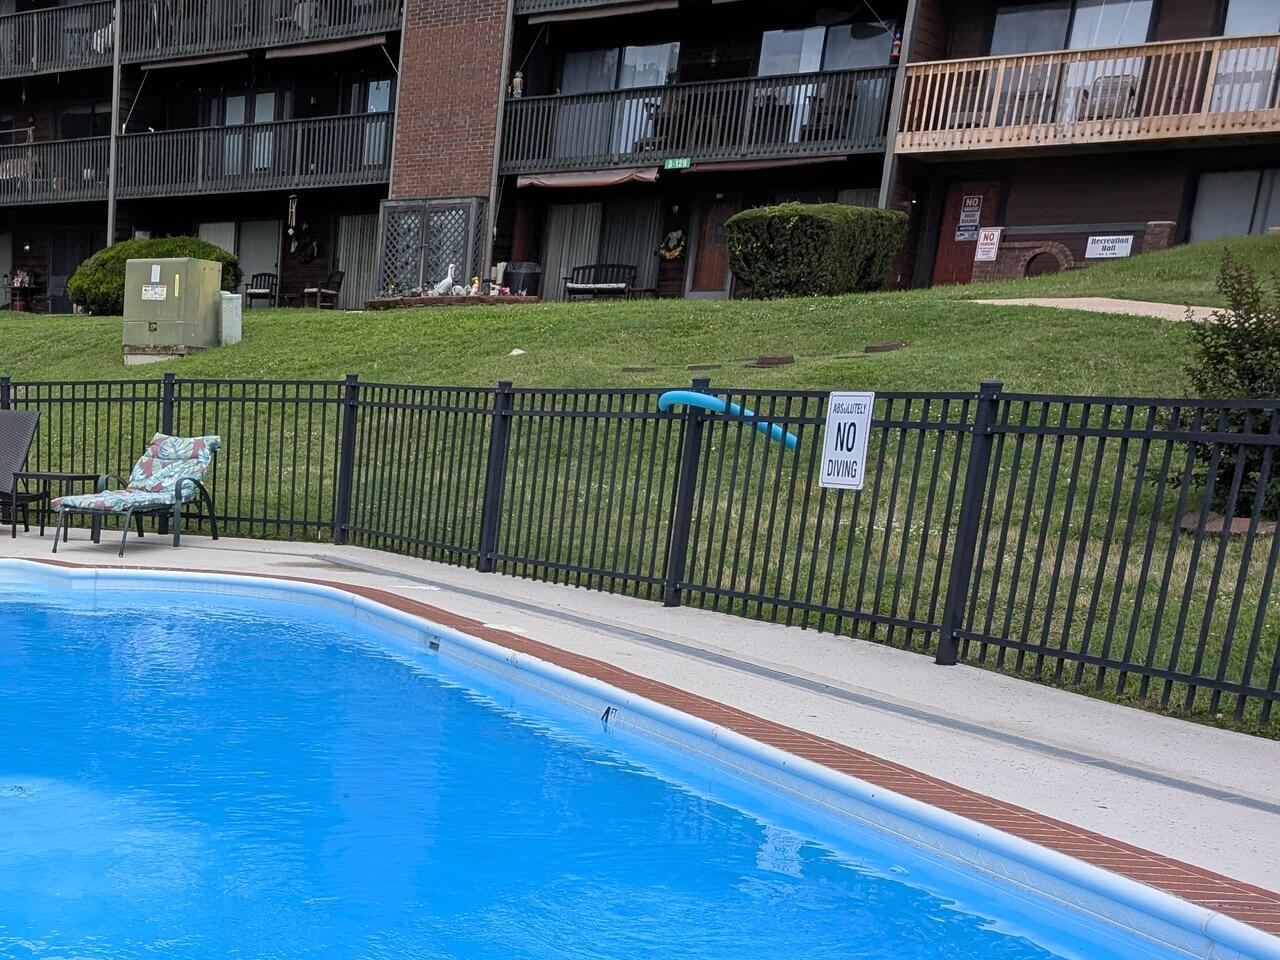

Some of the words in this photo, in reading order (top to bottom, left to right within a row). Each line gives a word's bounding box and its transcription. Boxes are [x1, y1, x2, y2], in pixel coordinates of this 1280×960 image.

[966, 198, 979, 207] NO
[983, 233, 995, 242] NO
[833, 402, 867, 415] ABSOLUTELY
[835, 422, 857, 453] NO
[826, 459, 858, 478] DIVING
